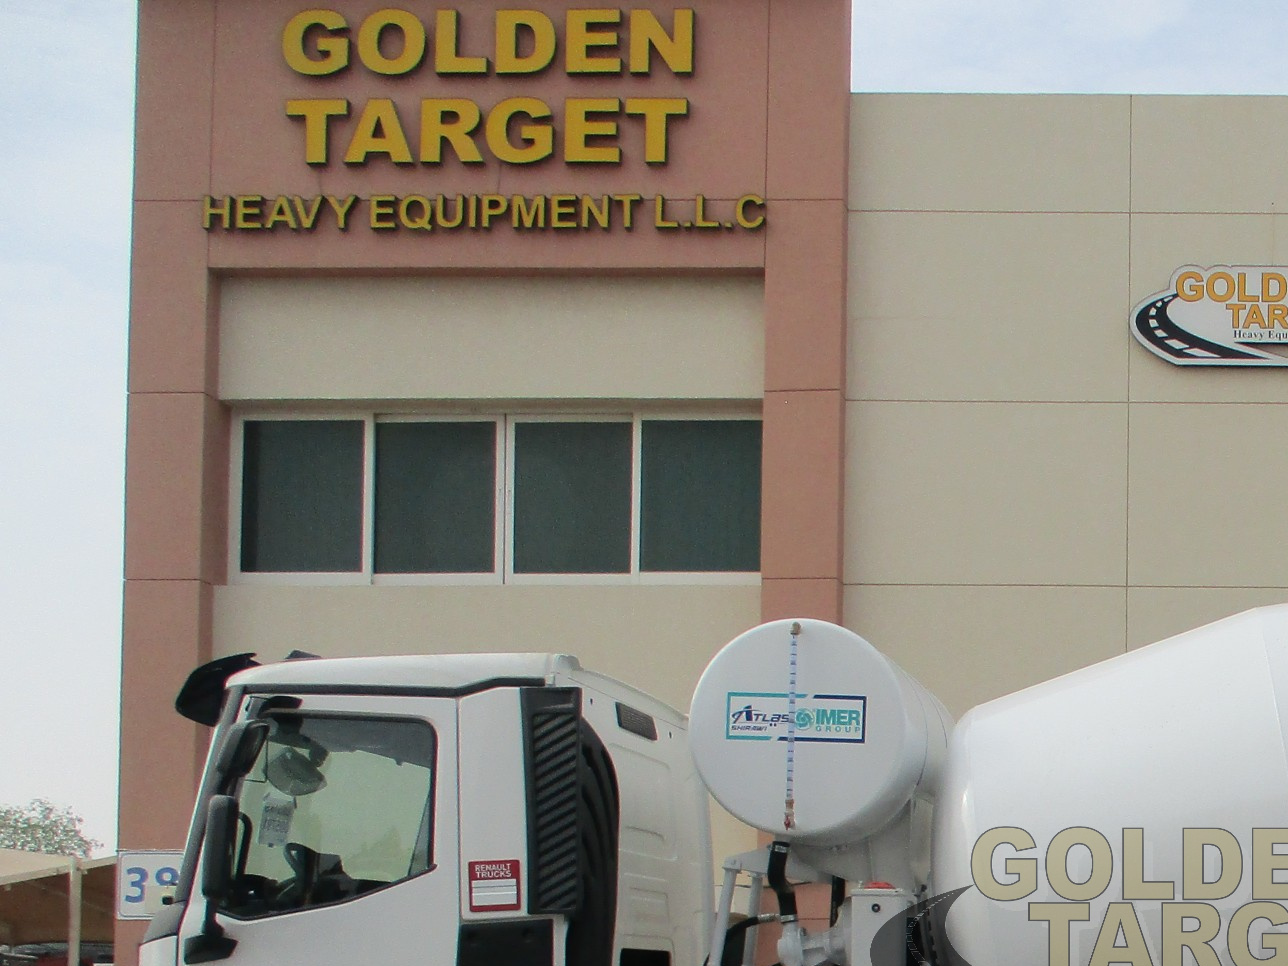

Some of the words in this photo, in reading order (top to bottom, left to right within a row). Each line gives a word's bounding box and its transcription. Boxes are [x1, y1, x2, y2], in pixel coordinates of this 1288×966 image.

[282, 8, 694, 76] GOLDEN
[286, 97, 689, 165] TARGET
[203, 195, 357, 231] HEAVY
[369, 194, 641, 231] EQUIPMENT
[654, 196, 766, 230] L.L.C
[1233, 330, 1264, 341] Heavy
[815, 708, 861, 726] IMER
[475, 863, 511, 872] RENAULT
[475, 870, 512, 878] TRUCKS
